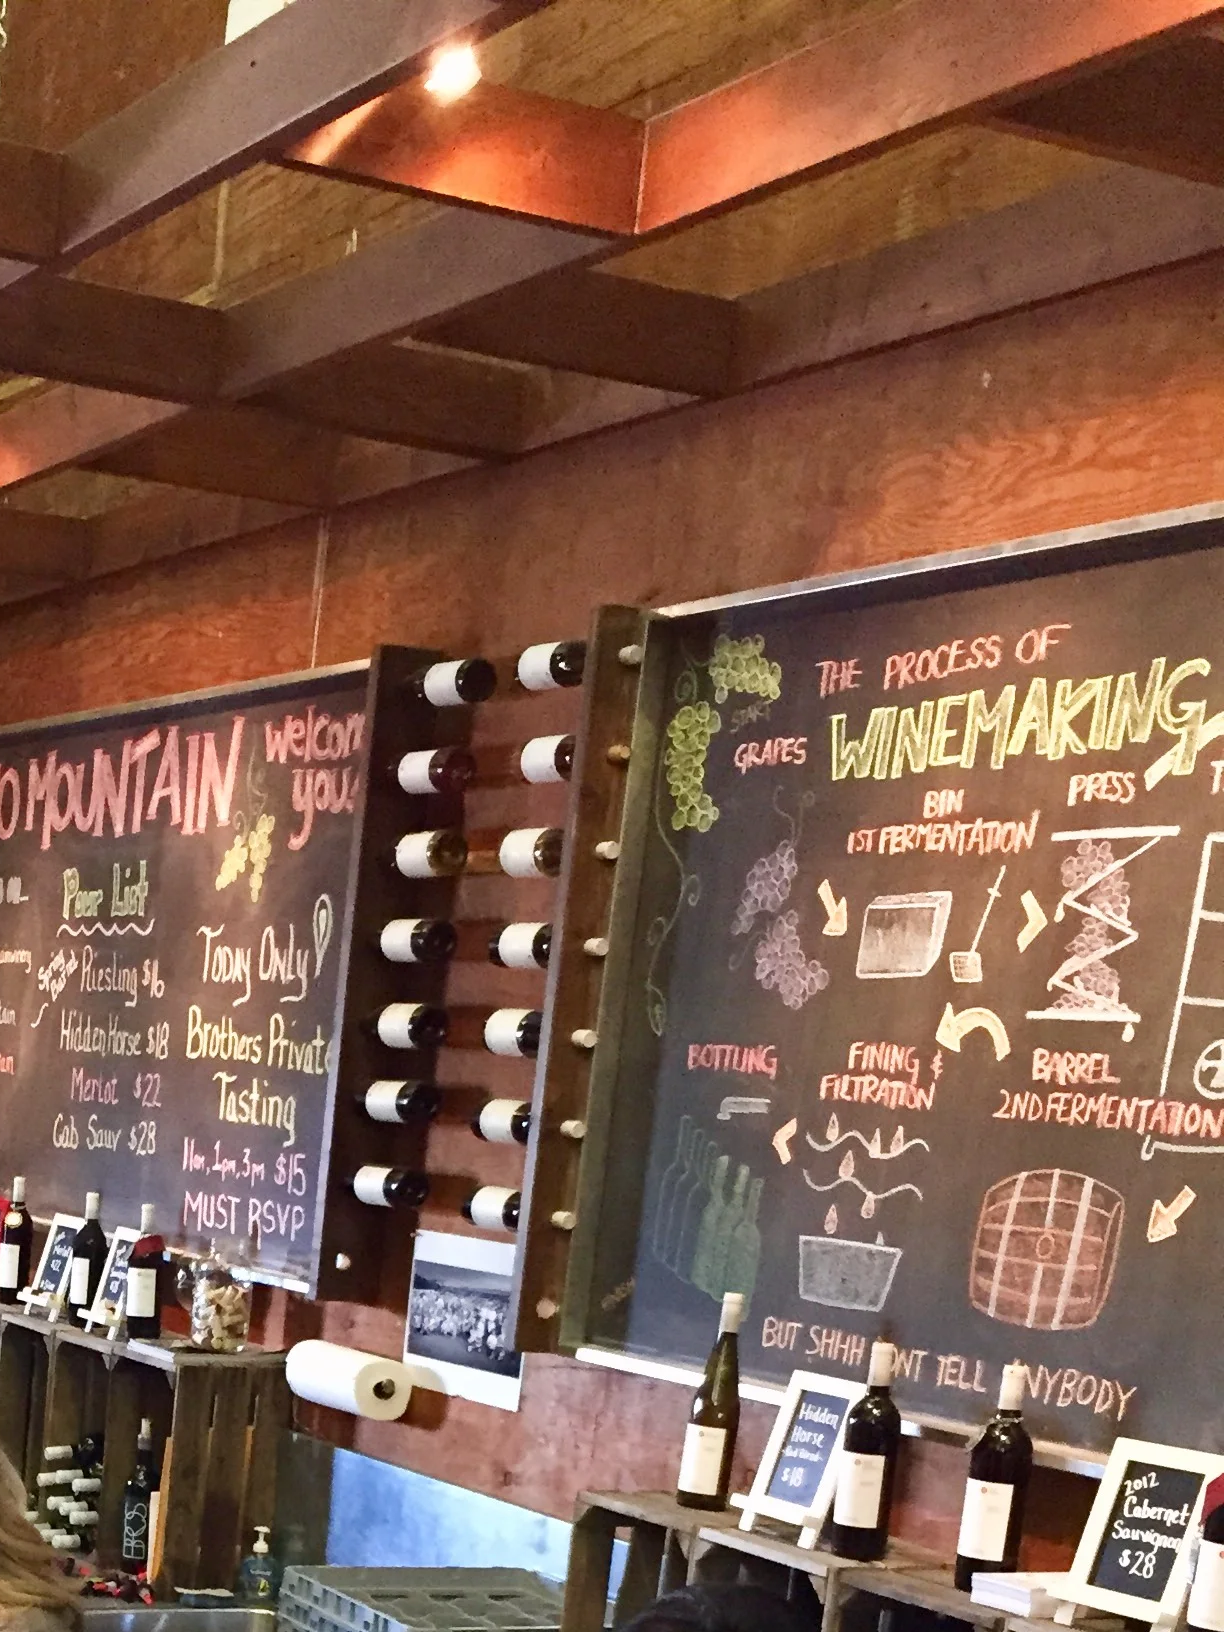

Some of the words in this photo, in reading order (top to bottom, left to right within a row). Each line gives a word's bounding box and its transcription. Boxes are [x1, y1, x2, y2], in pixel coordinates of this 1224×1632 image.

[815, 658, 863, 699] THE
[883, 634, 1005, 691] PROCESS
[1015, 623, 1073, 665] OF
[829, 656, 1212, 782] WINEMAKING
[733, 736, 808, 775] GRAPES
[24, 715, 245, 852] MOUNTAIN
[922, 788, 965, 819] BIN
[1067, 770, 1136, 807] PRESS
[878, 809, 1041, 857] FERMENTATION
[110, 859, 150, 918] List
[80, 945, 138, 1007] Riesling
[141, 959, 165, 998] $16
[59, 1008, 107, 1058] Hidden
[107, 1012, 142, 1056] Horse
[145, 1020, 170, 1060] $18
[185, 1004, 263, 1064] Brothers
[687, 1043, 778, 1080] BOTTLING
[847, 1040, 920, 1085] FINING
[1031, 1047, 1122, 1086] BARREL
[69, 1066, 120, 1105] Merlot
[132, 1071, 162, 1108] $22
[212, 1071, 297, 1148] Tasting
[819, 1073, 937, 1111] FILTRATION
[52, 1113, 79, 1150] Cab
[86, 1113, 122, 1151] Sauv
[127, 1121, 157, 1156] $28
[991, 1088, 1044, 1122] 2ND
[1044, 1090, 1224, 1140] FERMENTATION
[274, 1152, 307, 1197] $15
[183, 1190, 242, 1235] MUST
[247, 1198, 306, 1251] RSVP
[761, 1315, 804, 1351] BUT
[805, 1323, 867, 1368] SHHH
[936, 1352, 987, 1393] TELL
[790, 1424, 826, 1450] Horse
[798, 1402, 840, 1431] Hidden
[1123, 1471, 1160, 1497] 2012
[1122, 1494, 1191, 1528] Cabernet
[1118, 1548, 1157, 1580] $28
